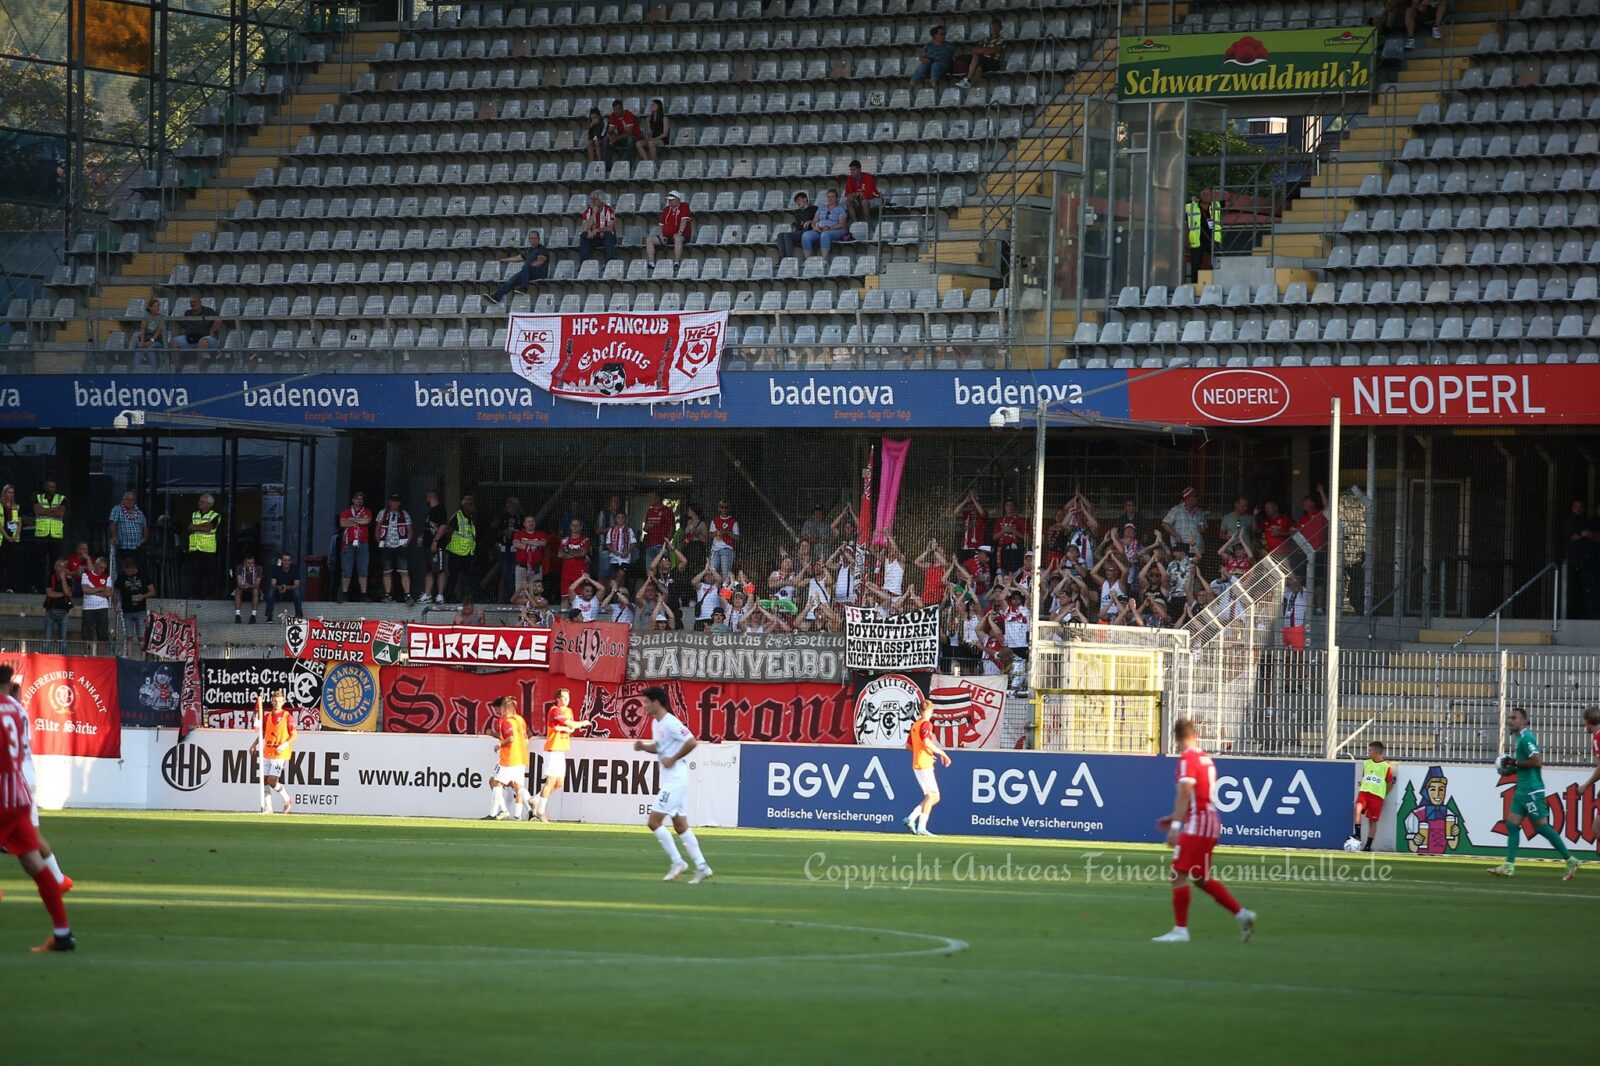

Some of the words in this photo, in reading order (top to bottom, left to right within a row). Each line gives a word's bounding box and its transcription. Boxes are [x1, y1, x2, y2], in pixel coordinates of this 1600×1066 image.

[1124, 61, 1369, 96] Schwarzwaldmilch
[524, 332, 547, 341] HFC
[686, 328, 716, 341] HFC
[578, 341, 652, 372] Edelfans
[75, 381, 188, 407] badenova
[243, 381, 359, 407] badenova
[414, 381, 533, 407] badenova
[770, 377, 894, 405] badenova
[955, 377, 1083, 405] badenova
[1353, 374, 1545, 414] NEOPERL
[311, 629, 371, 643] MANSFELD
[794, 631, 846, 648] Sektio
[848, 623, 937, 639] BOYKOTTIEREN
[313, 644, 364, 662] SÜDHARZ
[410, 632, 549, 662] SURREALE
[848, 639, 937, 654] MONTAGSSPIELE
[303, 660, 325, 675] HFC
[848, 652, 873, 666] NICHT
[874, 653, 936, 667] AKZEPTIEREN
[206, 666, 259, 685] Libertà
[260, 668, 299, 684] Crew
[331, 667, 372, 692] FANSZENE
[868, 678, 916, 696] Ultras
[22, 671, 75, 709] LUBFREUNDE
[77, 675, 108, 713] ANHALT
[206, 688, 257, 704] Chemie
[327, 688, 371, 721] LOKOMOTIVE
[35, 719, 60, 731] Alte
[64, 718, 98, 735] Säcke
[696, 686, 853, 743] front
[162, 743, 211, 797] AHP
[358, 766, 483, 794] www.ahp.de
[768, 762, 849, 798] BGV
[295, 793, 339, 806] BEWEGT
[972, 768, 1057, 806] BGV
[1215, 776, 1273, 814] GV
[767, 807, 813, 820] Badische
[816, 809, 894, 823] Versicherungen
[971, 814, 1019, 828] Badische
[1022, 815, 1104, 832] Versicherungen
[1236, 824, 1322, 840] Versicherungen
